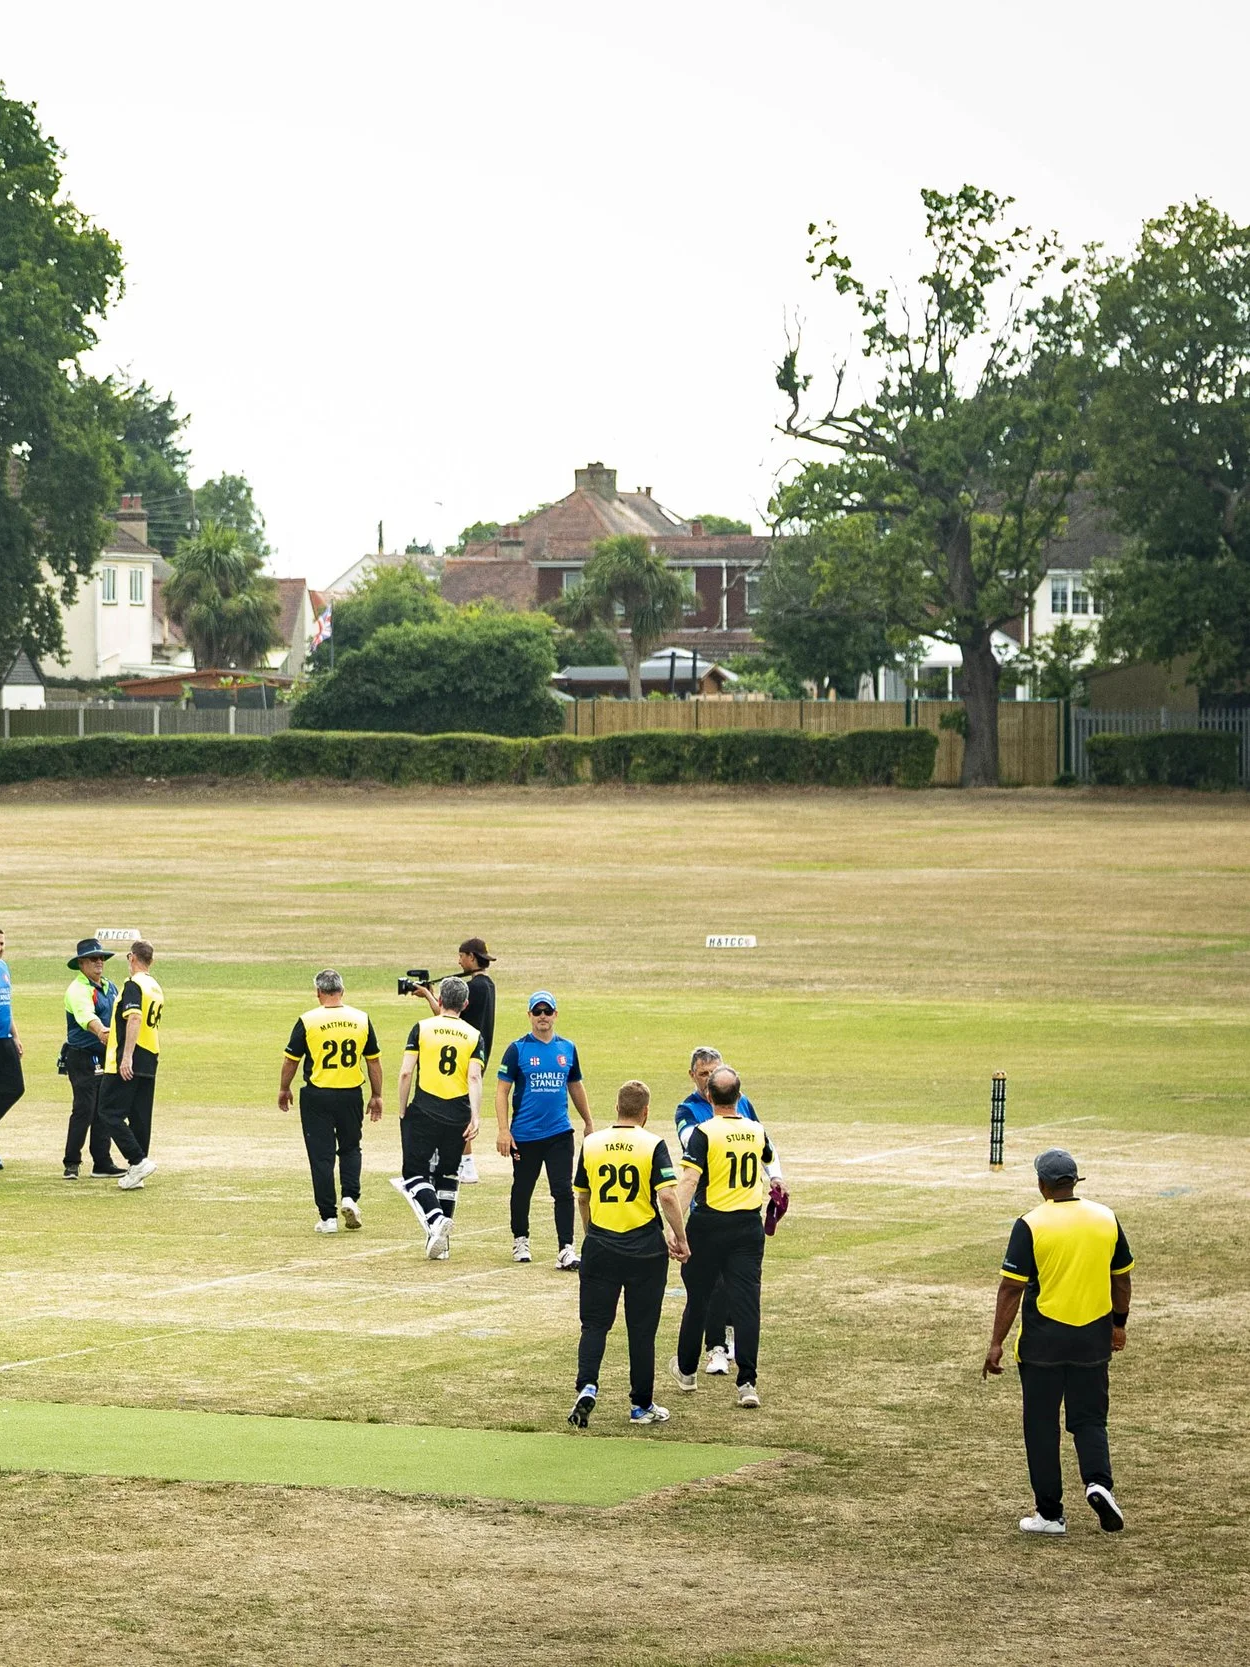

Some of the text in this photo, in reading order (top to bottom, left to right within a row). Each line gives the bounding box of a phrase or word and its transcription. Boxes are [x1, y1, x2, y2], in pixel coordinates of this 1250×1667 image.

[320, 1021, 358, 1032] MATTHEWS
[433, 1028, 469, 1040] POWLING
[322, 1039, 357, 1069] 28
[439, 1045, 457, 1076] 8
[530, 1072, 565, 1080] CHARLES
[726, 1133, 755, 1142] STUART
[605, 1142, 634, 1152] TASKIS
[726, 1151, 758, 1190] 10
[598, 1163, 640, 1203] 29
